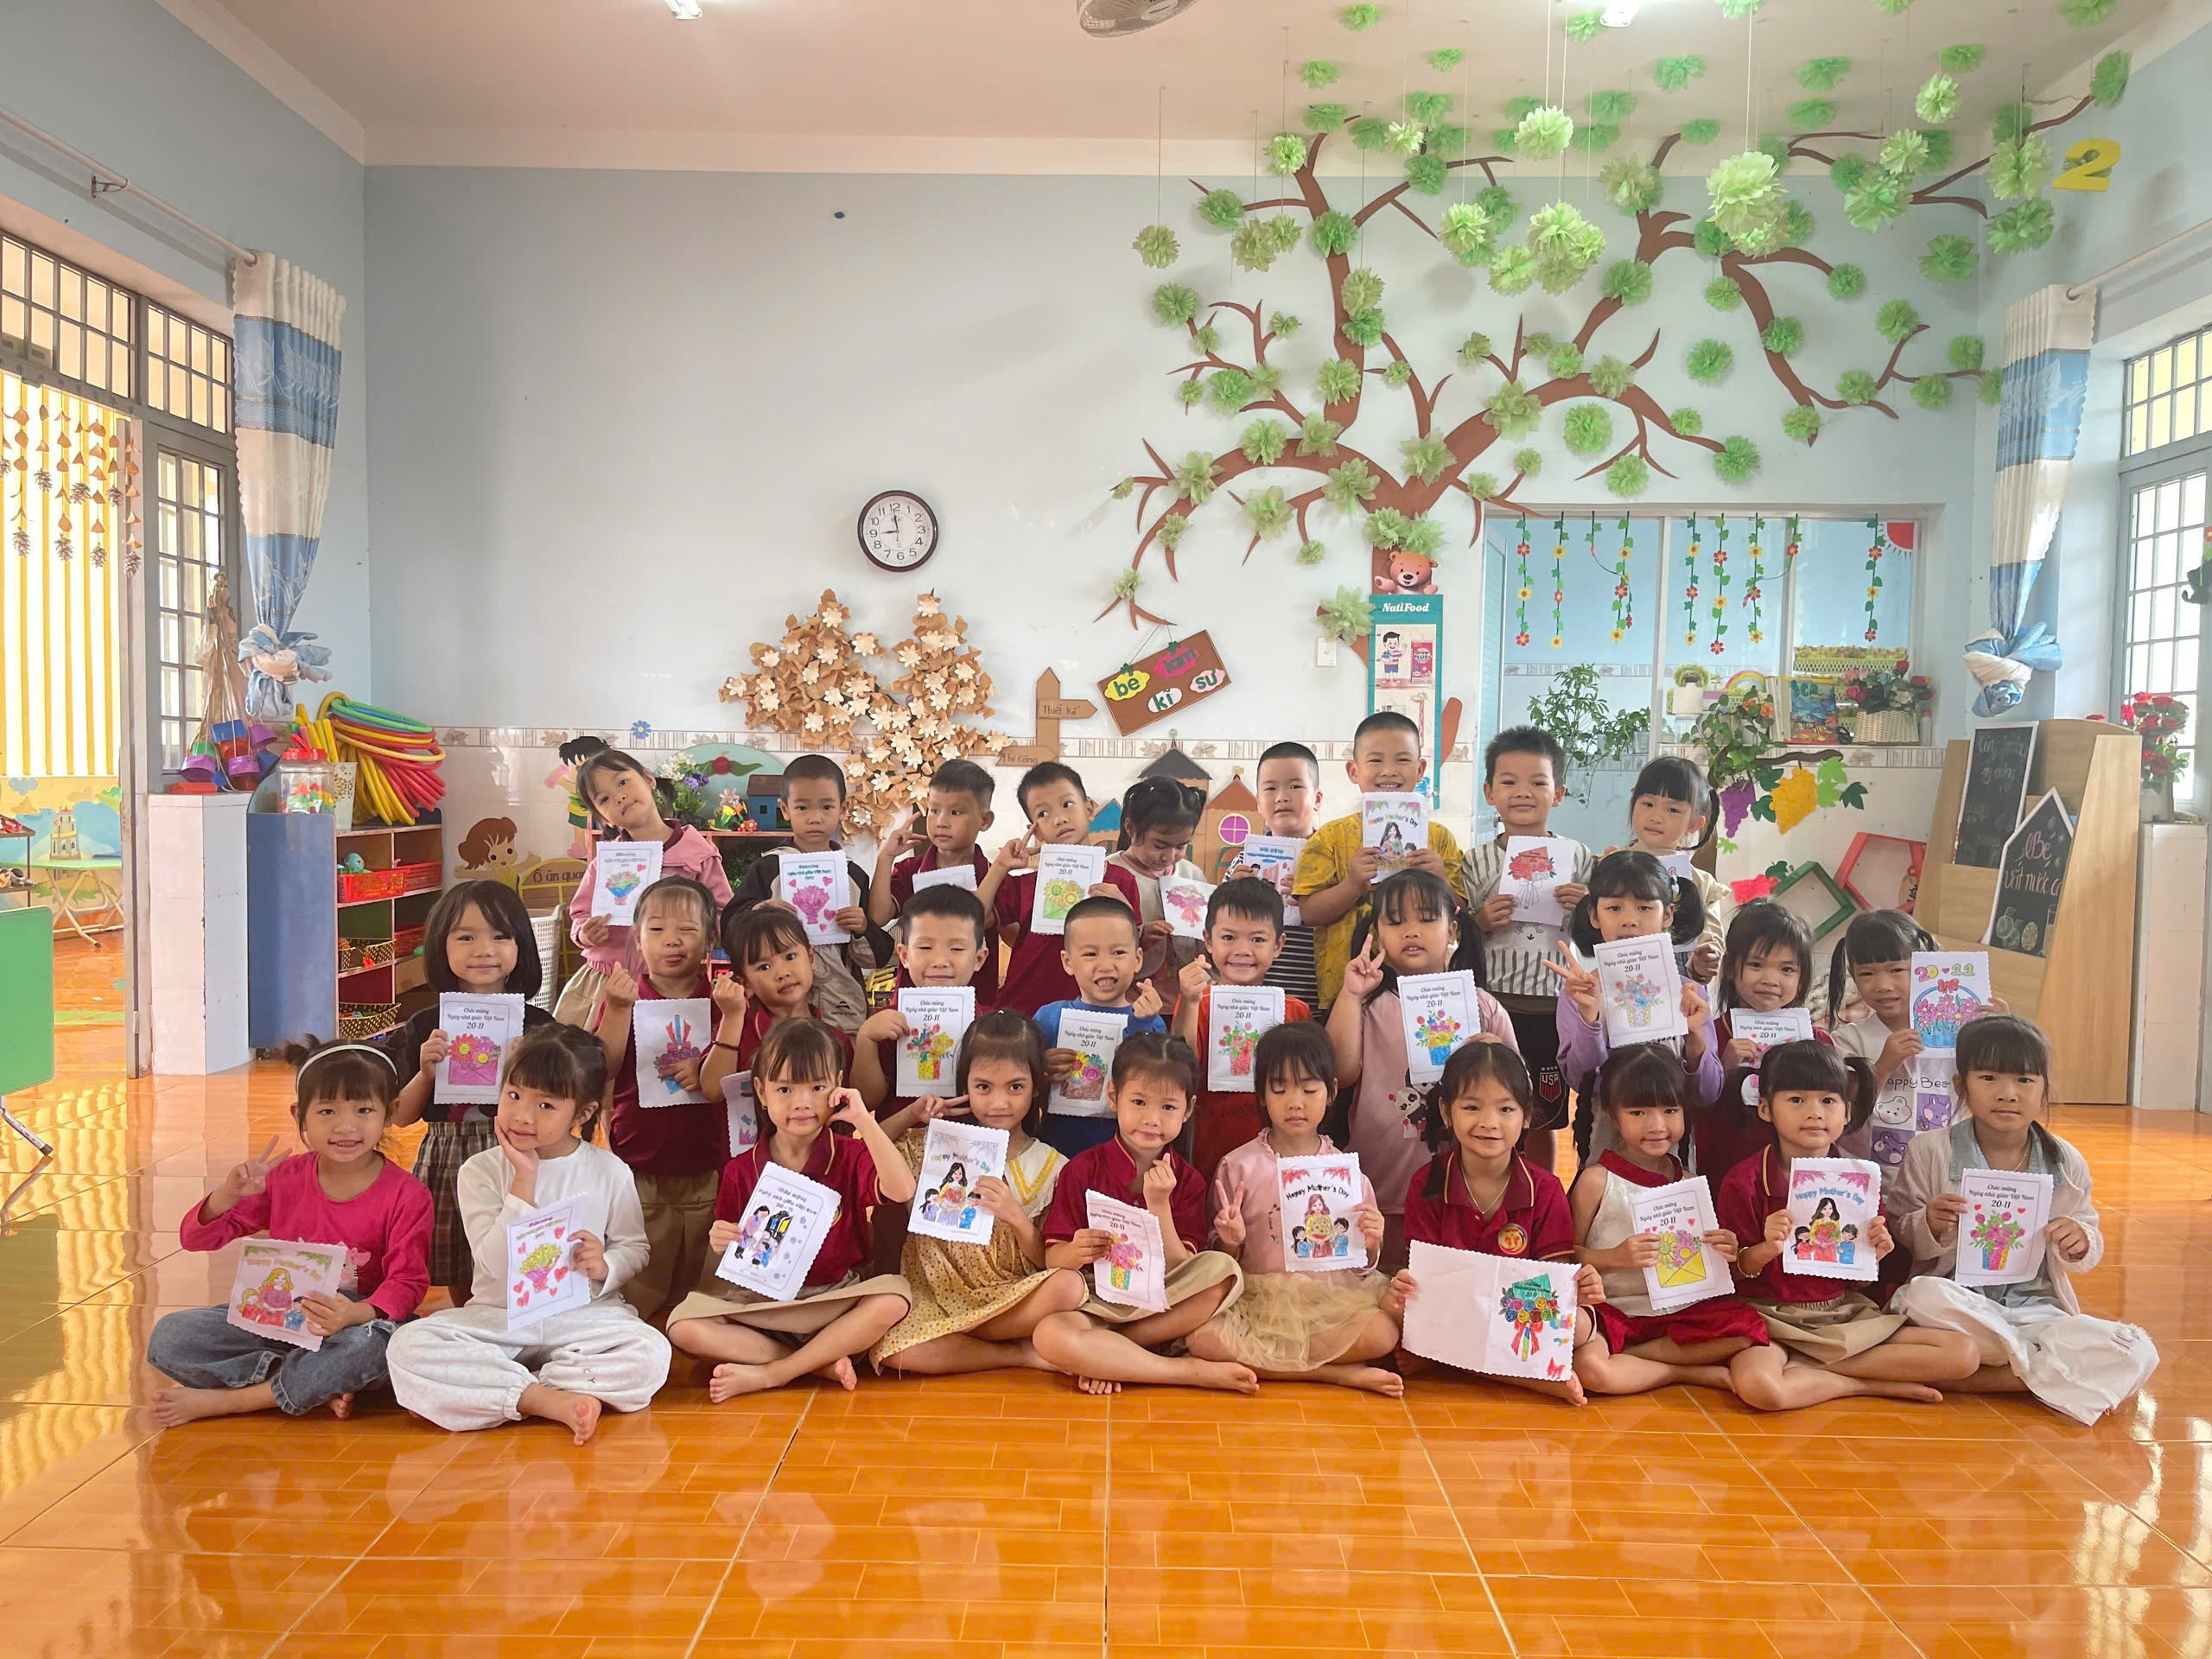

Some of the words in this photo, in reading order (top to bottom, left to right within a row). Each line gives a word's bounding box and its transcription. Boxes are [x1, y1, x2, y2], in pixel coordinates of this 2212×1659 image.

[2053, 138, 2122, 193] 2
[879, 507, 885, 516] 11
[890, 503, 900, 512] 12
[907, 505, 911, 514] 1
[915, 513, 922, 522] 2
[1195, 668, 1217, 690] sư
[1002, 753, 1015, 763] Thi
[1915, 965, 1938, 982] 20
[1951, 963, 1974, 976] 11
[1286, 1188, 1306, 1200] Happy
[1307, 1184, 1336, 1192] Mother's
[1338, 1187, 1349, 1198] Day
[1796, 1190, 1816, 1201] Happy
[1109, 1222, 1124, 1230] 20-11
[1660, 1217, 1675, 1226] 20-11
